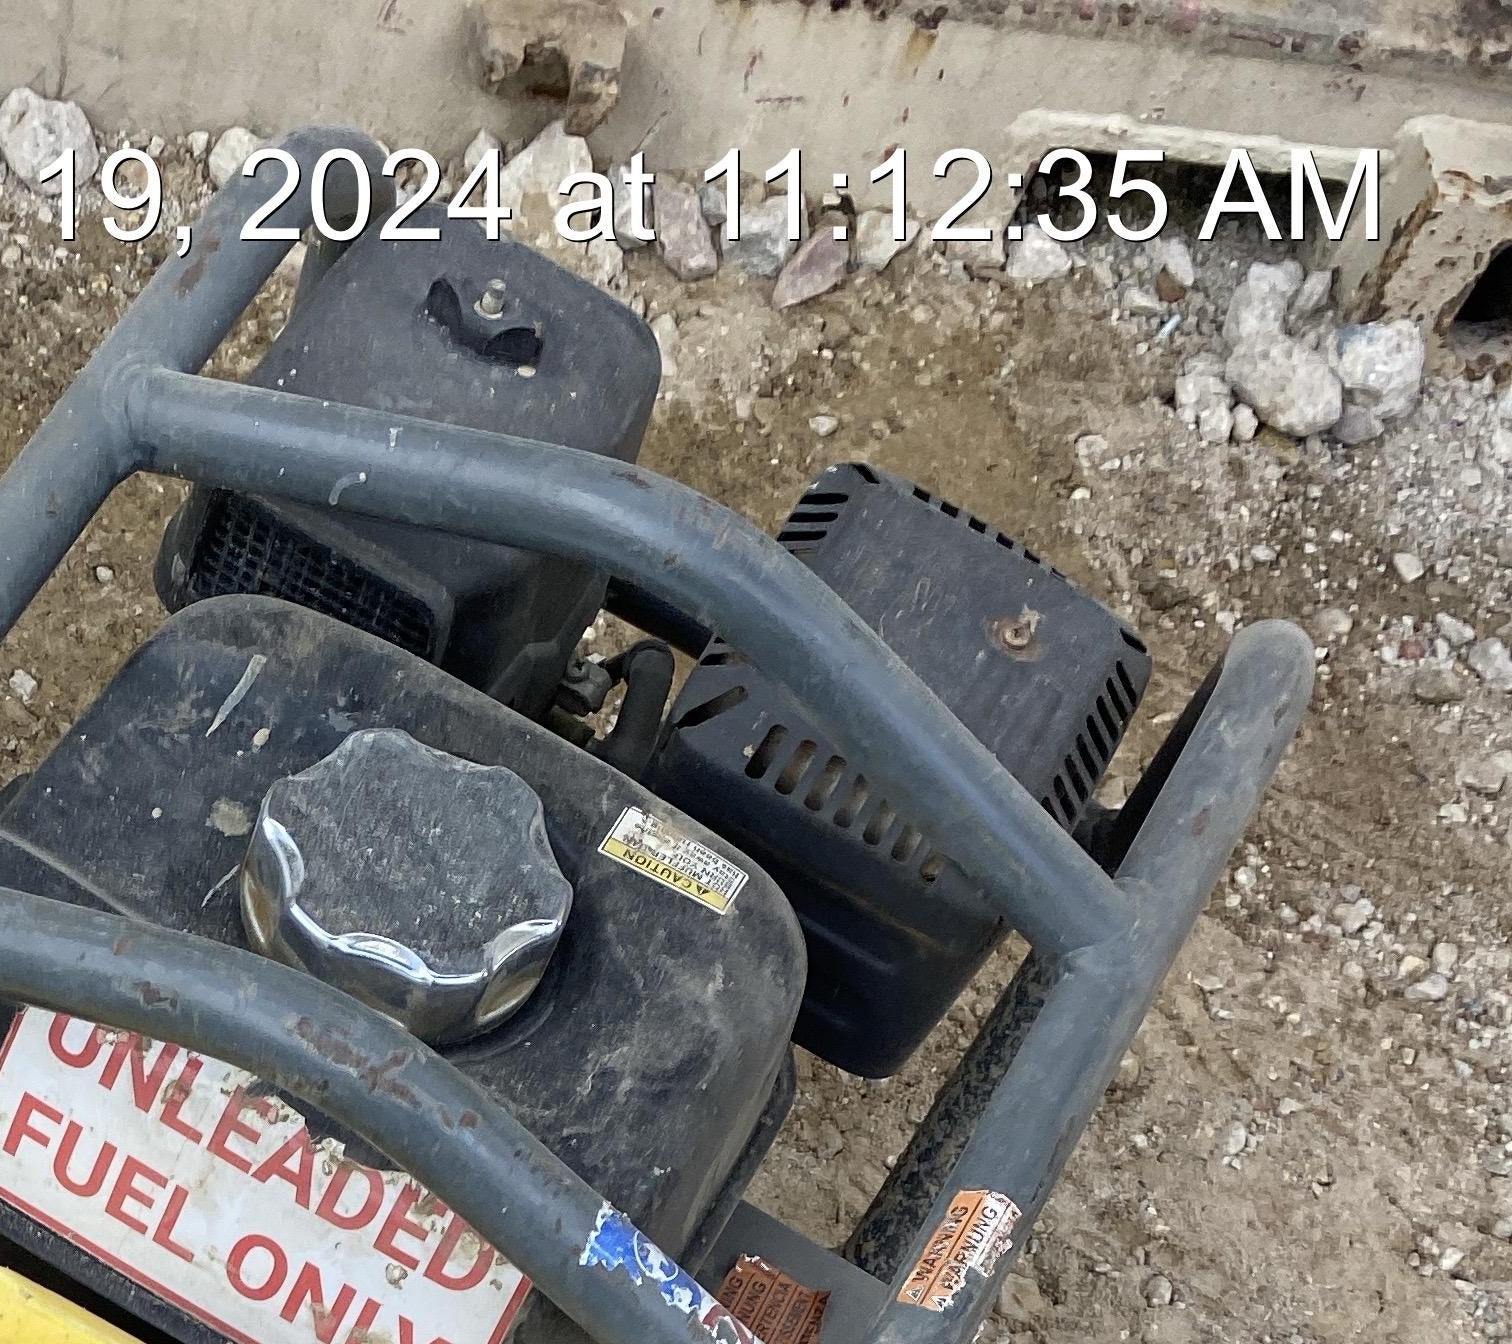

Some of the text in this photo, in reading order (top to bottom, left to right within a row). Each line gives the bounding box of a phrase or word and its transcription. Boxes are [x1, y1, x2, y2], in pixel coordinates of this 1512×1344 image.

[622, 848, 692, 889] CAUTION
[1, 1092, 195, 1262] FUEL
[48, 1012, 495, 1291] UNLEADED
[912, 1206, 968, 1282] WARNING
